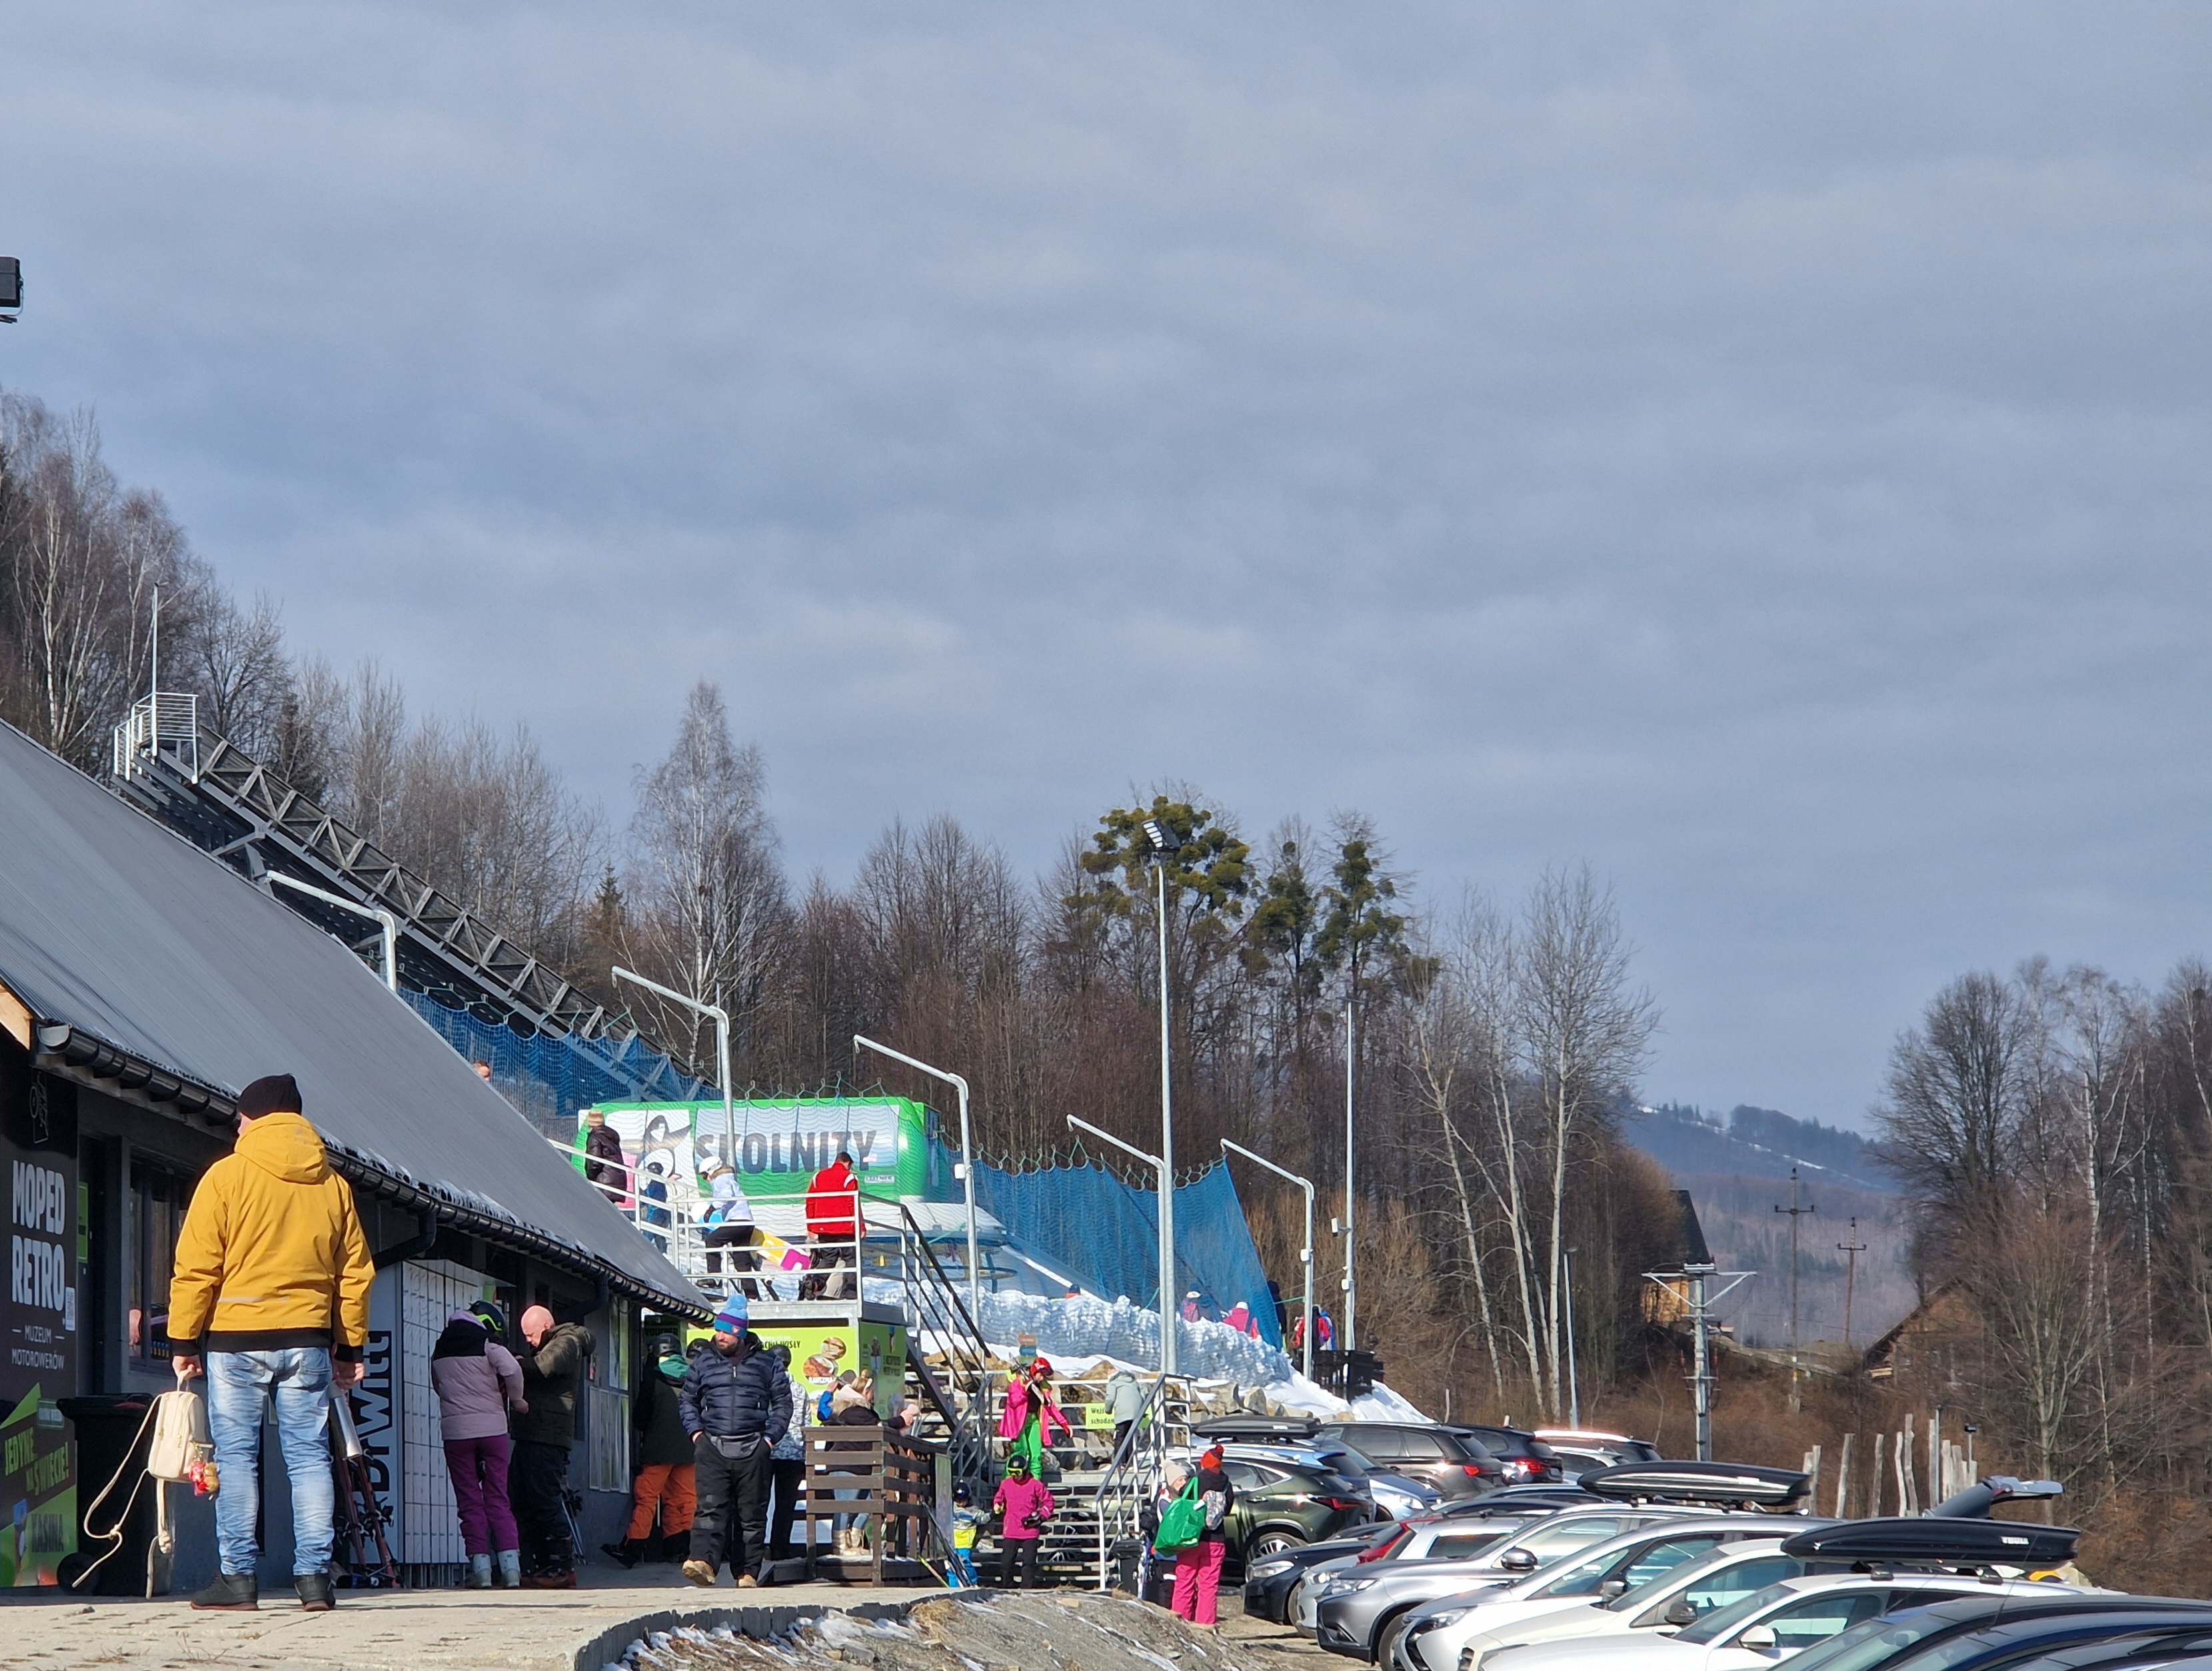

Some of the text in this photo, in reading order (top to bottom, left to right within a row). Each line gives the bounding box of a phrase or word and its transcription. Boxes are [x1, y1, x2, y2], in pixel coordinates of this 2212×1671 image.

[12, 1159, 65, 1235] MOPED
[11, 1234, 65, 1311] RETRO
[11, 1348, 65, 1370] MOTOROWERÓW
[25, 1325, 51, 1344] MUZEUM
